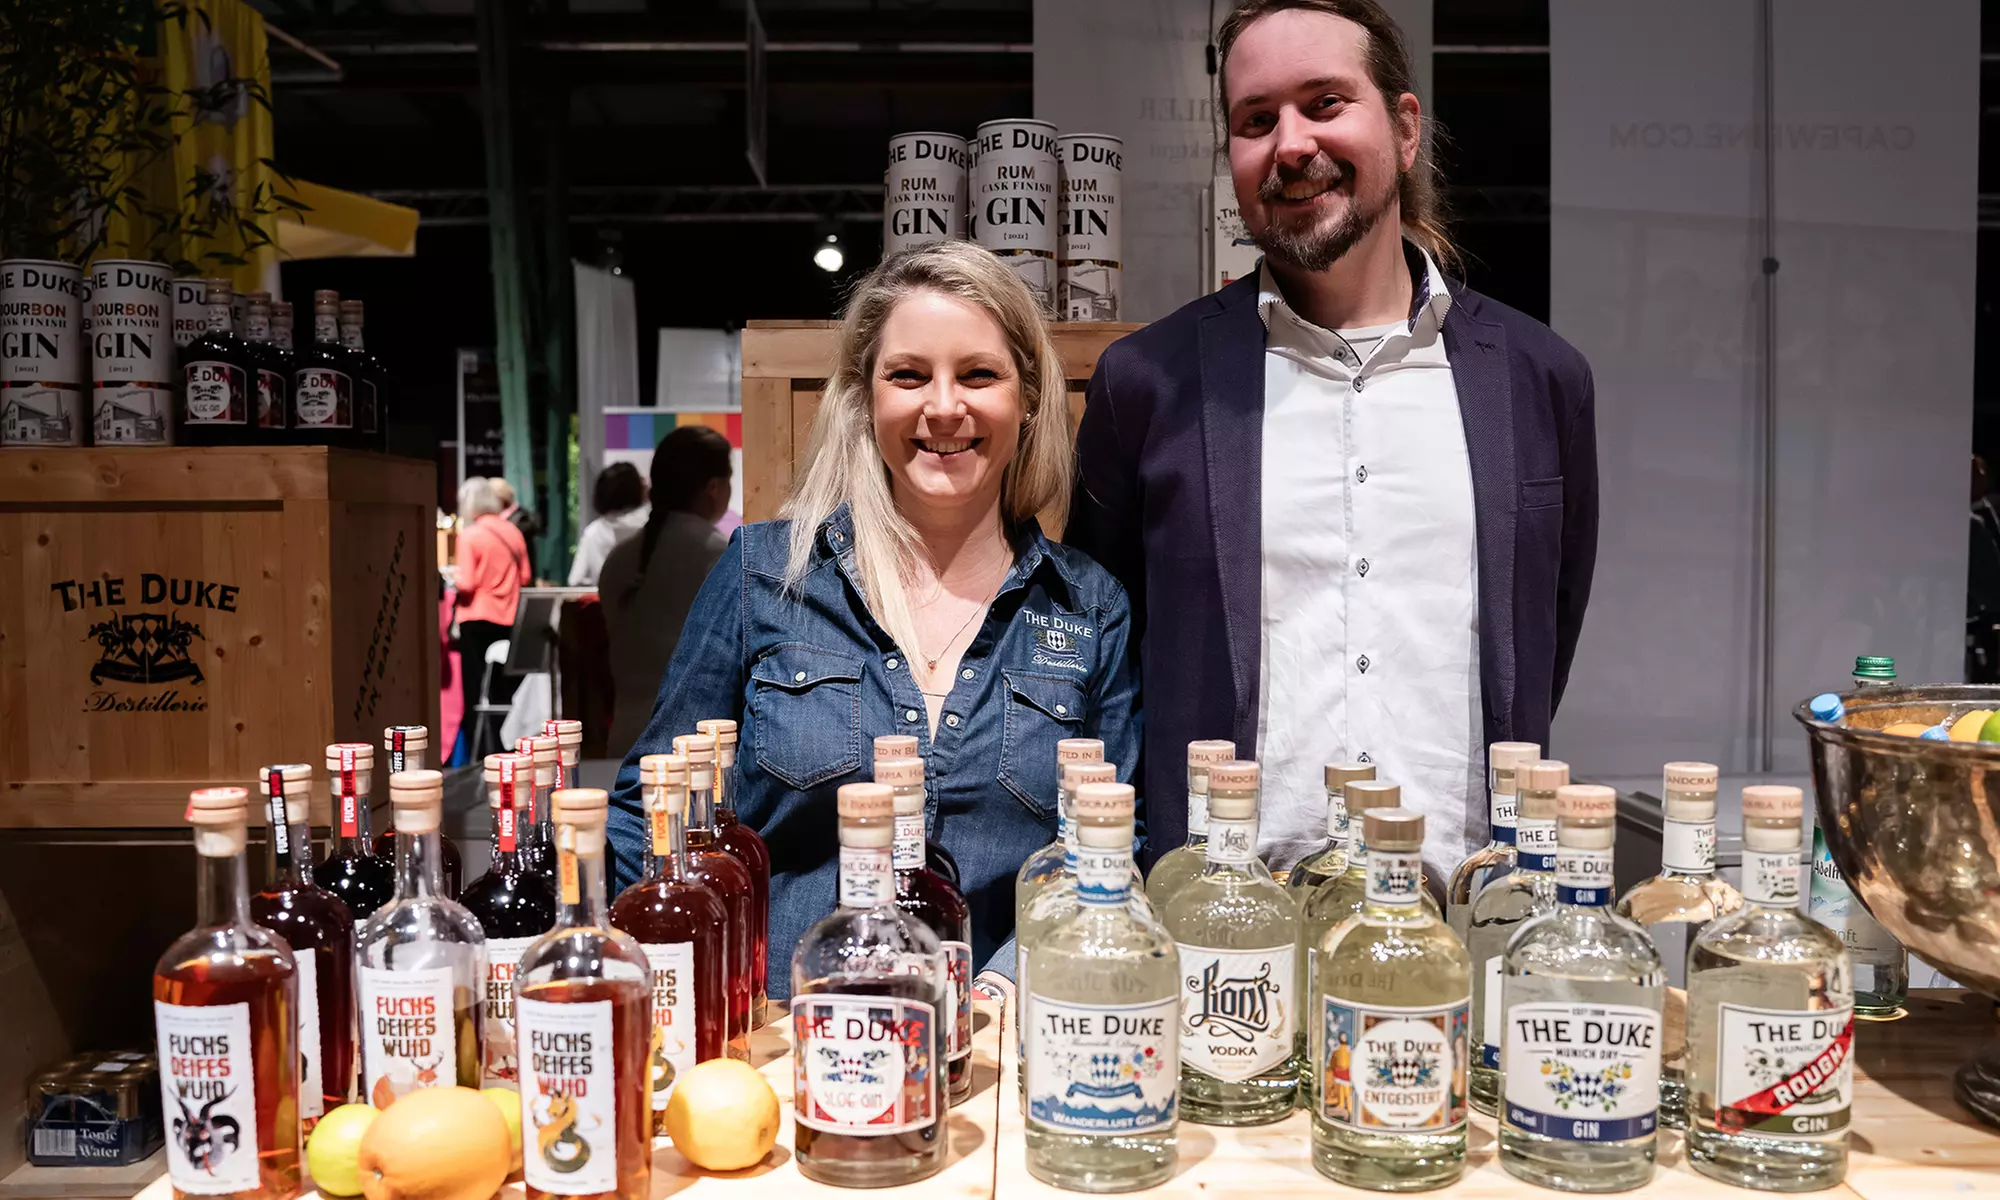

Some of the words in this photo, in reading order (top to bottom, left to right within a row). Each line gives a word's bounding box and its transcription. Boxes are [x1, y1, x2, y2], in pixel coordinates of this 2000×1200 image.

[889, 144, 906, 164] HE
[915, 140, 965, 169] DUKE
[1073, 143, 1122, 171] DUKE
[998, 166, 1035, 179] RUM
[901, 178, 937, 191] RUM
[982, 182, 1008, 193] CASK
[1013, 182, 1051, 193] FINISH
[1061, 179, 1097, 192] RUM
[914, 193, 954, 203] FINISH
[1076, 194, 1114, 204] FINISH
[986, 197, 1046, 226] GIN
[892, 208, 949, 236] GIN
[1057, 209, 1109, 237] GIN
[0, 272, 14, 291] HE
[23, 269, 79, 298] DUKE
[92, 272, 108, 290] HE
[117, 269, 172, 296] DUKE
[179, 287, 208, 304] DU
[2, 317, 19, 327] ASK
[95, 317, 113, 327] ASK
[2, 332, 58, 359] GIN
[95, 332, 152, 359] GIN
[51, 578, 125, 612] THE
[141, 573, 241, 613] DUKE
[1023, 609, 1049, 627] THE
[1053, 616, 1094, 639] DUKE
[82, 690, 209, 712] Destillerie
[1519, 830, 1544, 843] THE
[1695, 828, 1713, 838] THE
[1583, 861, 1611, 874] DUK
[1758, 857, 1782, 868] THE
[1576, 889, 1596, 903] GIN
[947, 961, 968, 982] KE
[376, 996, 436, 1016] FUCHS
[377, 1017, 437, 1037] DEIFES
[795, 1015, 835, 1042] THE
[846, 1018, 925, 1047] DUKE
[1047, 1014, 1091, 1035] THE
[1104, 1014, 1164, 1036] DUKE
[1516, 1019, 1571, 1043] THE
[1584, 1021, 1655, 1049] DUKE
[1749, 1022, 1802, 1043] THE
[1813, 1020, 1844, 1040] DU
[169, 1033, 229, 1056] FUCHS
[382, 1038, 432, 1058] WUID
[532, 1030, 592, 1053] FUCHS
[1208, 1045, 1258, 1056] VODKA
[1366, 1040, 1397, 1054] THE
[1404, 1039, 1442, 1054] DUKE
[1556, 1048, 1596, 1059] MUNICH
[1600, 1050, 1619, 1060] DRY
[171, 1057, 231, 1078] DEIFES
[533, 1054, 593, 1076] DEIFES
[1772, 1042, 1845, 1107] ROUGH
[176, 1080, 226, 1101] WUID
[537, 1076, 588, 1098] WUID
[1364, 1090, 1441, 1106] ENTGEISTERT
[1572, 1120, 1600, 1139] GIN
[1791, 1116, 1830, 1133] GIN
[80, 1128, 117, 1143] Tonic
[80, 1144, 119, 1159] Water
